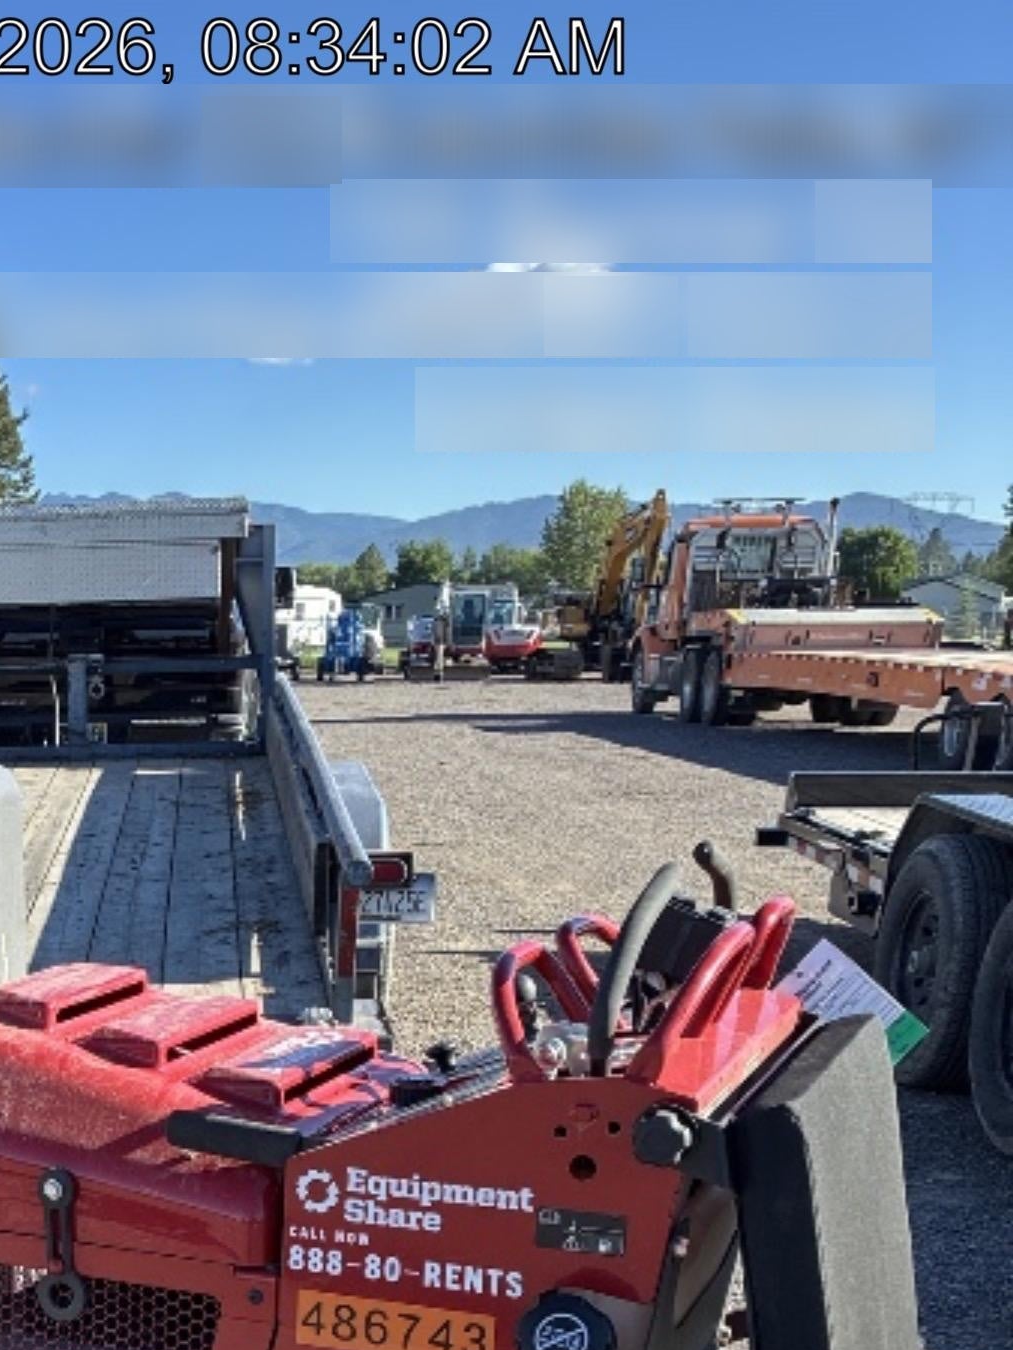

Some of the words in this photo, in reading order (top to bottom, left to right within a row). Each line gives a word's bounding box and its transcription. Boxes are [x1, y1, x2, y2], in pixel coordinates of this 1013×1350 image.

[346, 1166, 535, 1212] Equipment
[289, 1225, 327, 1242] CALL
[344, 1198, 443, 1232] Share
[288, 1245, 525, 1298] 888-80-RENTS
